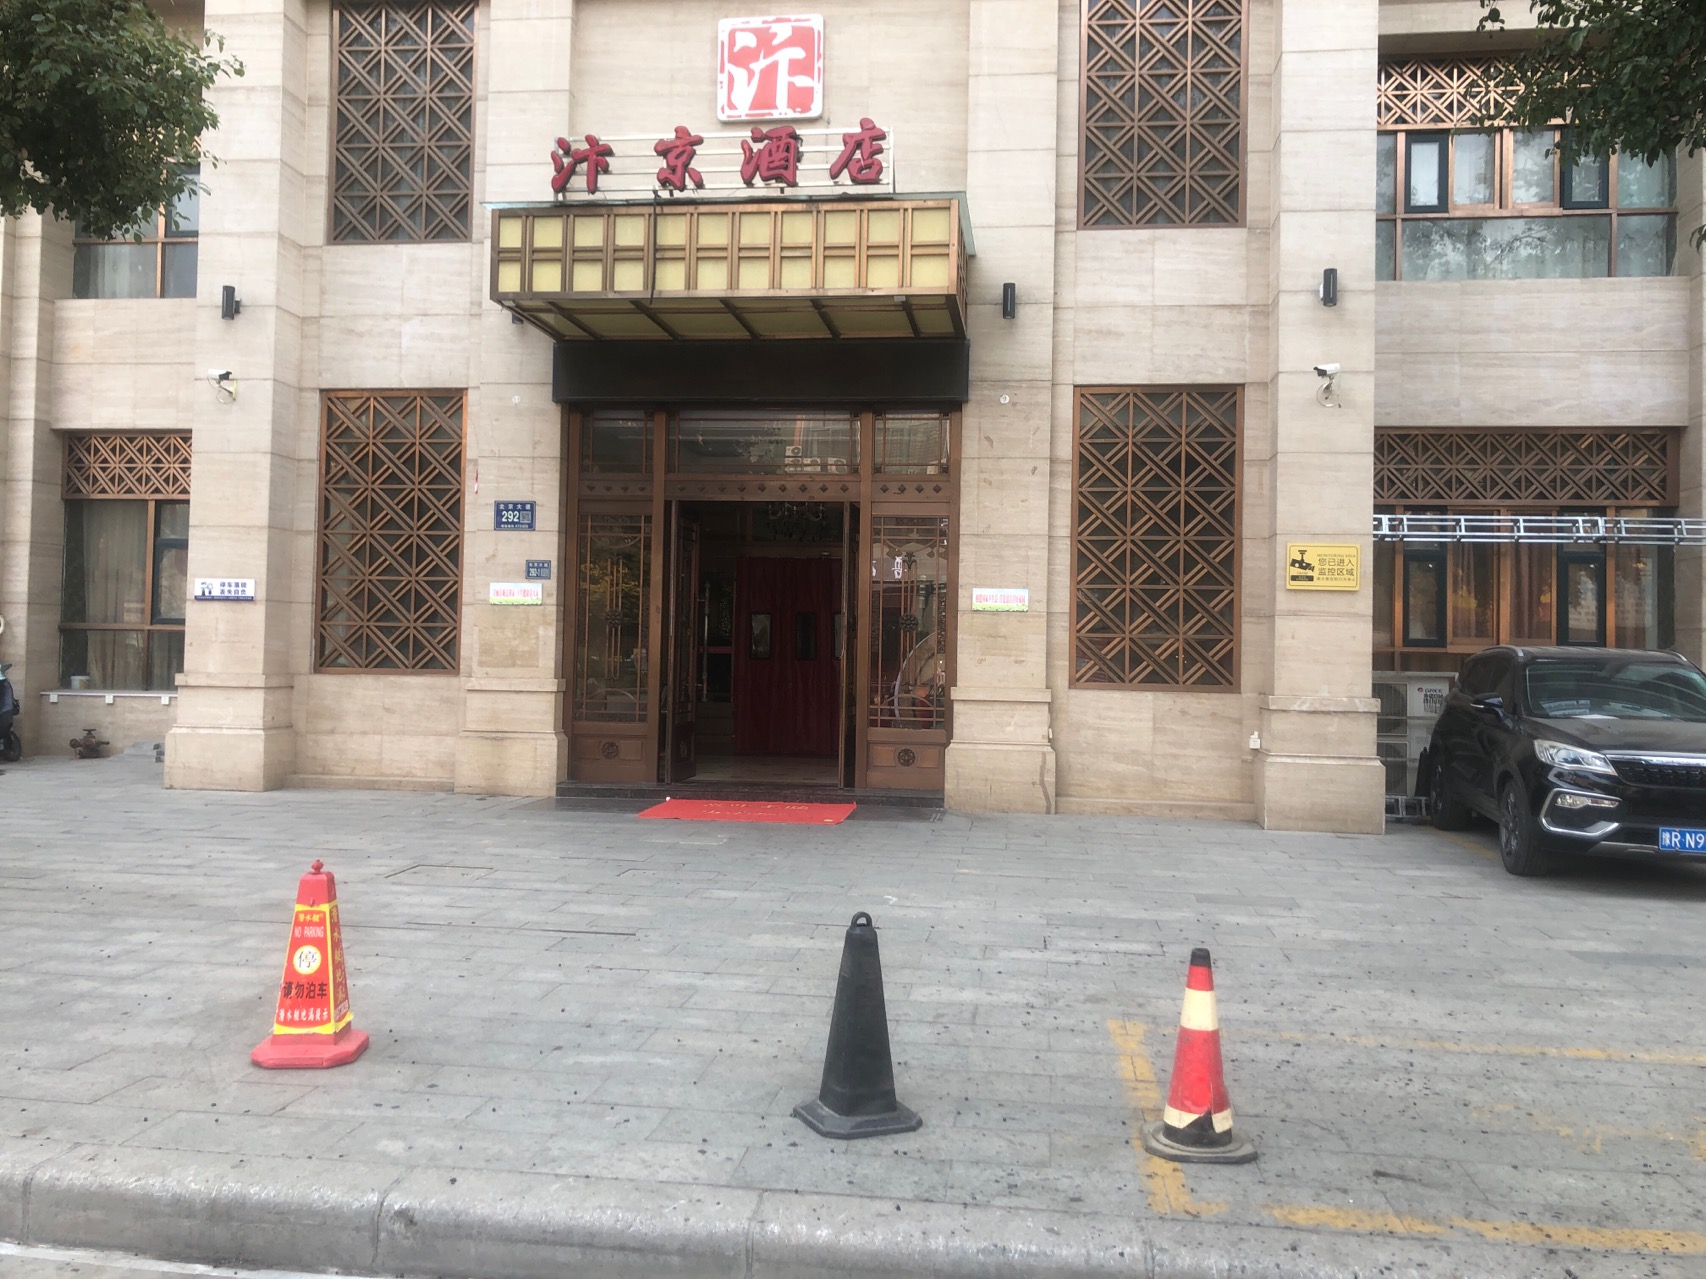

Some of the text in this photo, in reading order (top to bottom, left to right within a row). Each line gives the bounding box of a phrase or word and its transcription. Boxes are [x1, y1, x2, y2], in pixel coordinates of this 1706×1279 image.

[549, 117, 888, 195] 汴京酒店
[501, 510, 519, 522] 292
[1318, 558, 1355, 567] 您已进入
[1318, 567, 1355, 577] 监控区域
[294, 926, 325, 938] NO PARKING
[297, 950, 318, 969] 停
